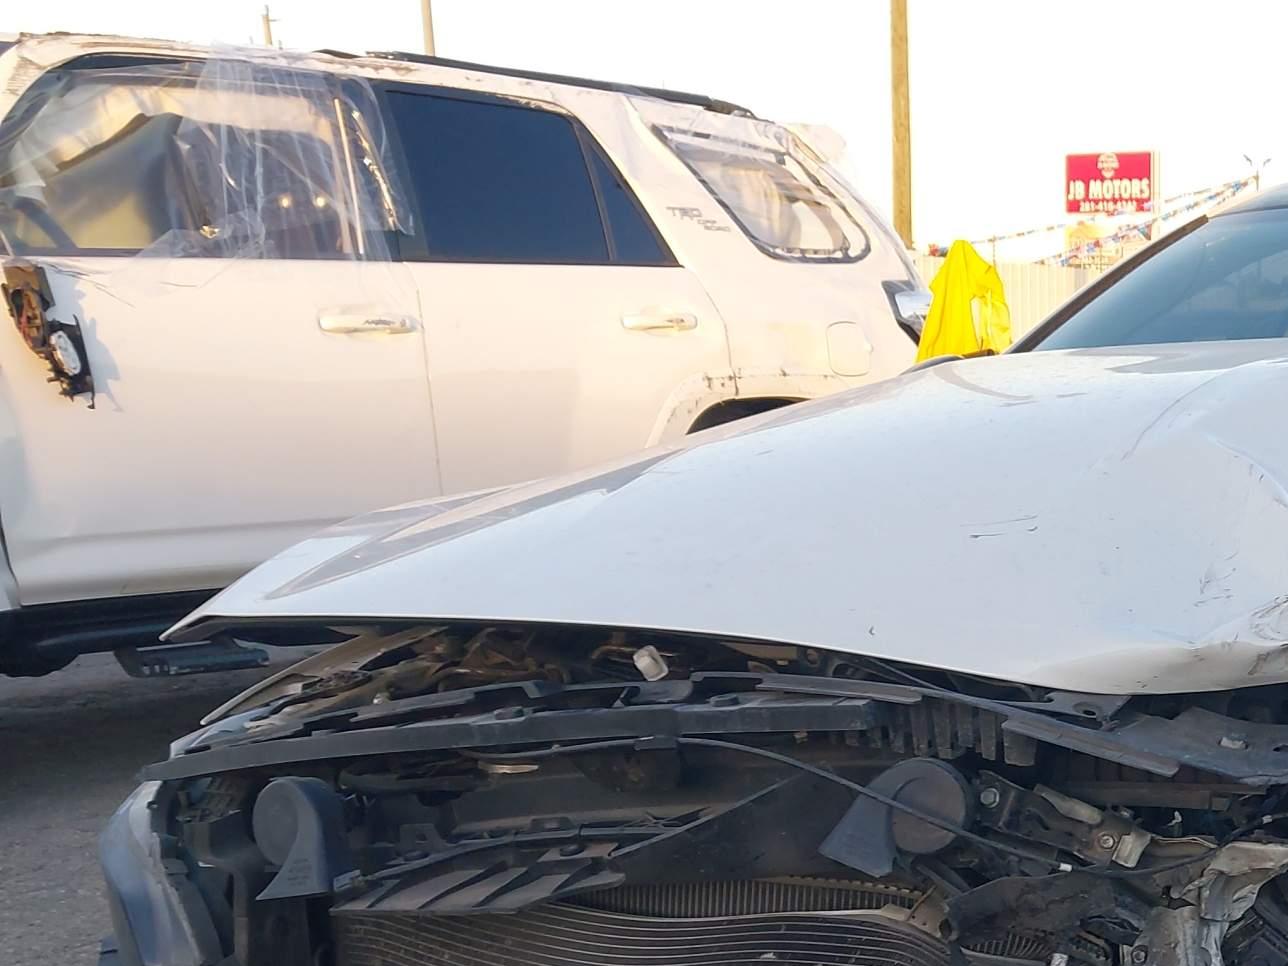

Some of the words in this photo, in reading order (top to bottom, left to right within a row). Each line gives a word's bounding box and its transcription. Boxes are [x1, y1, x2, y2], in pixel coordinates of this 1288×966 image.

[1067, 179, 1085, 200] JB
[1088, 178, 1150, 200] MOTORS
[665, 206, 703, 221] TRD
